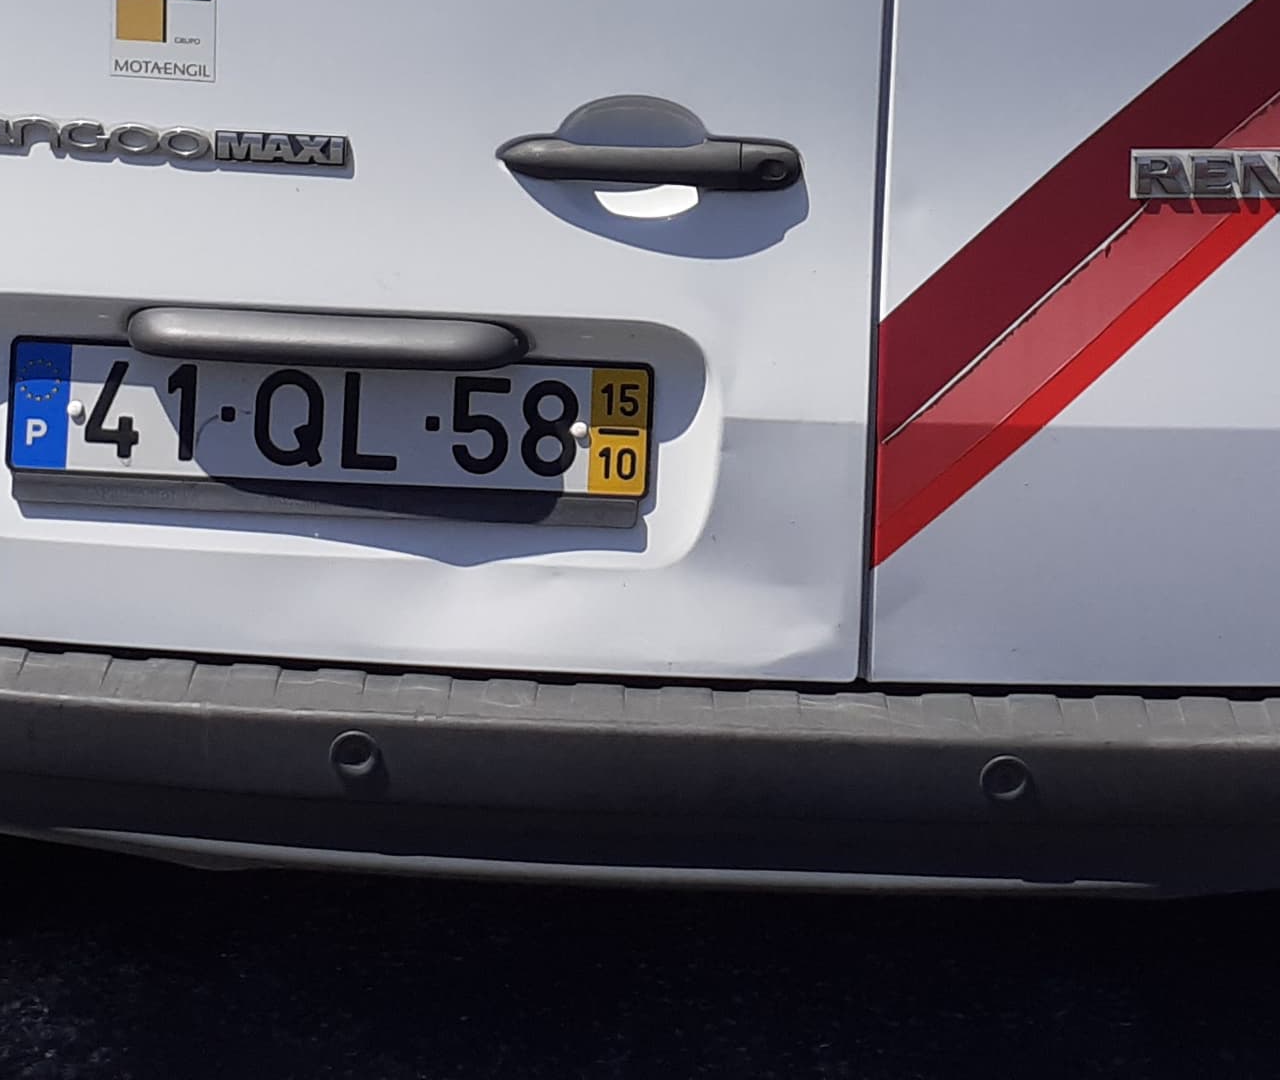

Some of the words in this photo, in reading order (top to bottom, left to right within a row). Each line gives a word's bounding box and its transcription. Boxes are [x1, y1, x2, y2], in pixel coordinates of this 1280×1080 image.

[216, 131, 347, 166] MAXI
[601, 383, 640, 417] 15
[25, 418, 48, 445] P
[598, 446, 637, 481] 10
